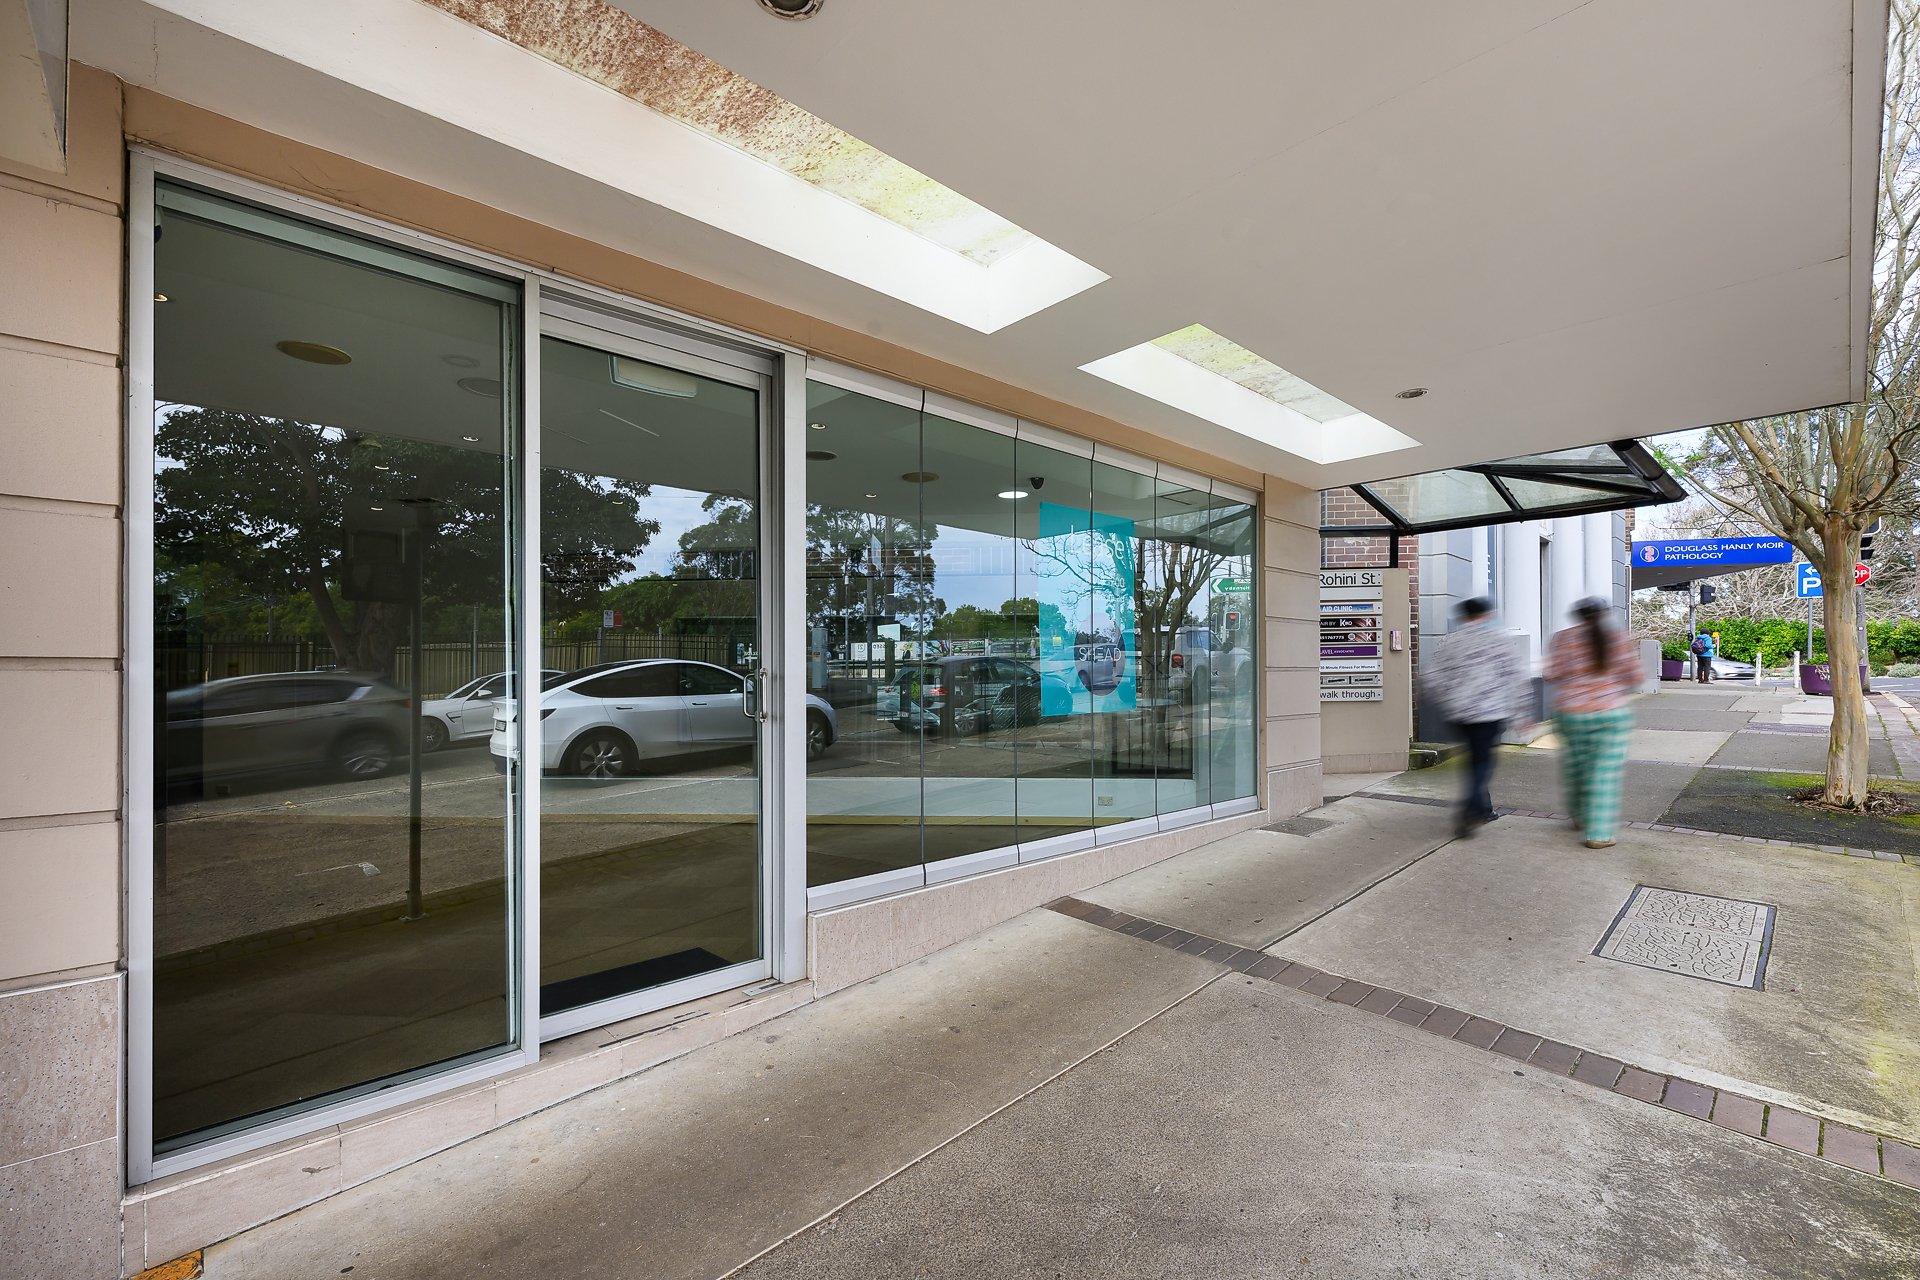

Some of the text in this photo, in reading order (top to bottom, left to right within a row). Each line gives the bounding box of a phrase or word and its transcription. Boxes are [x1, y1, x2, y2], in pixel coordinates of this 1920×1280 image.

[1664, 544, 1718, 553] DOUGLASS
[1756, 541, 1785, 549] MOIR
[1664, 552, 1724, 561] PATHOLOGY
[1320, 573, 1376, 586] Rohini St
[1802, 577, 1822, 595] P
[1320, 690, 1376, 700] walk through
